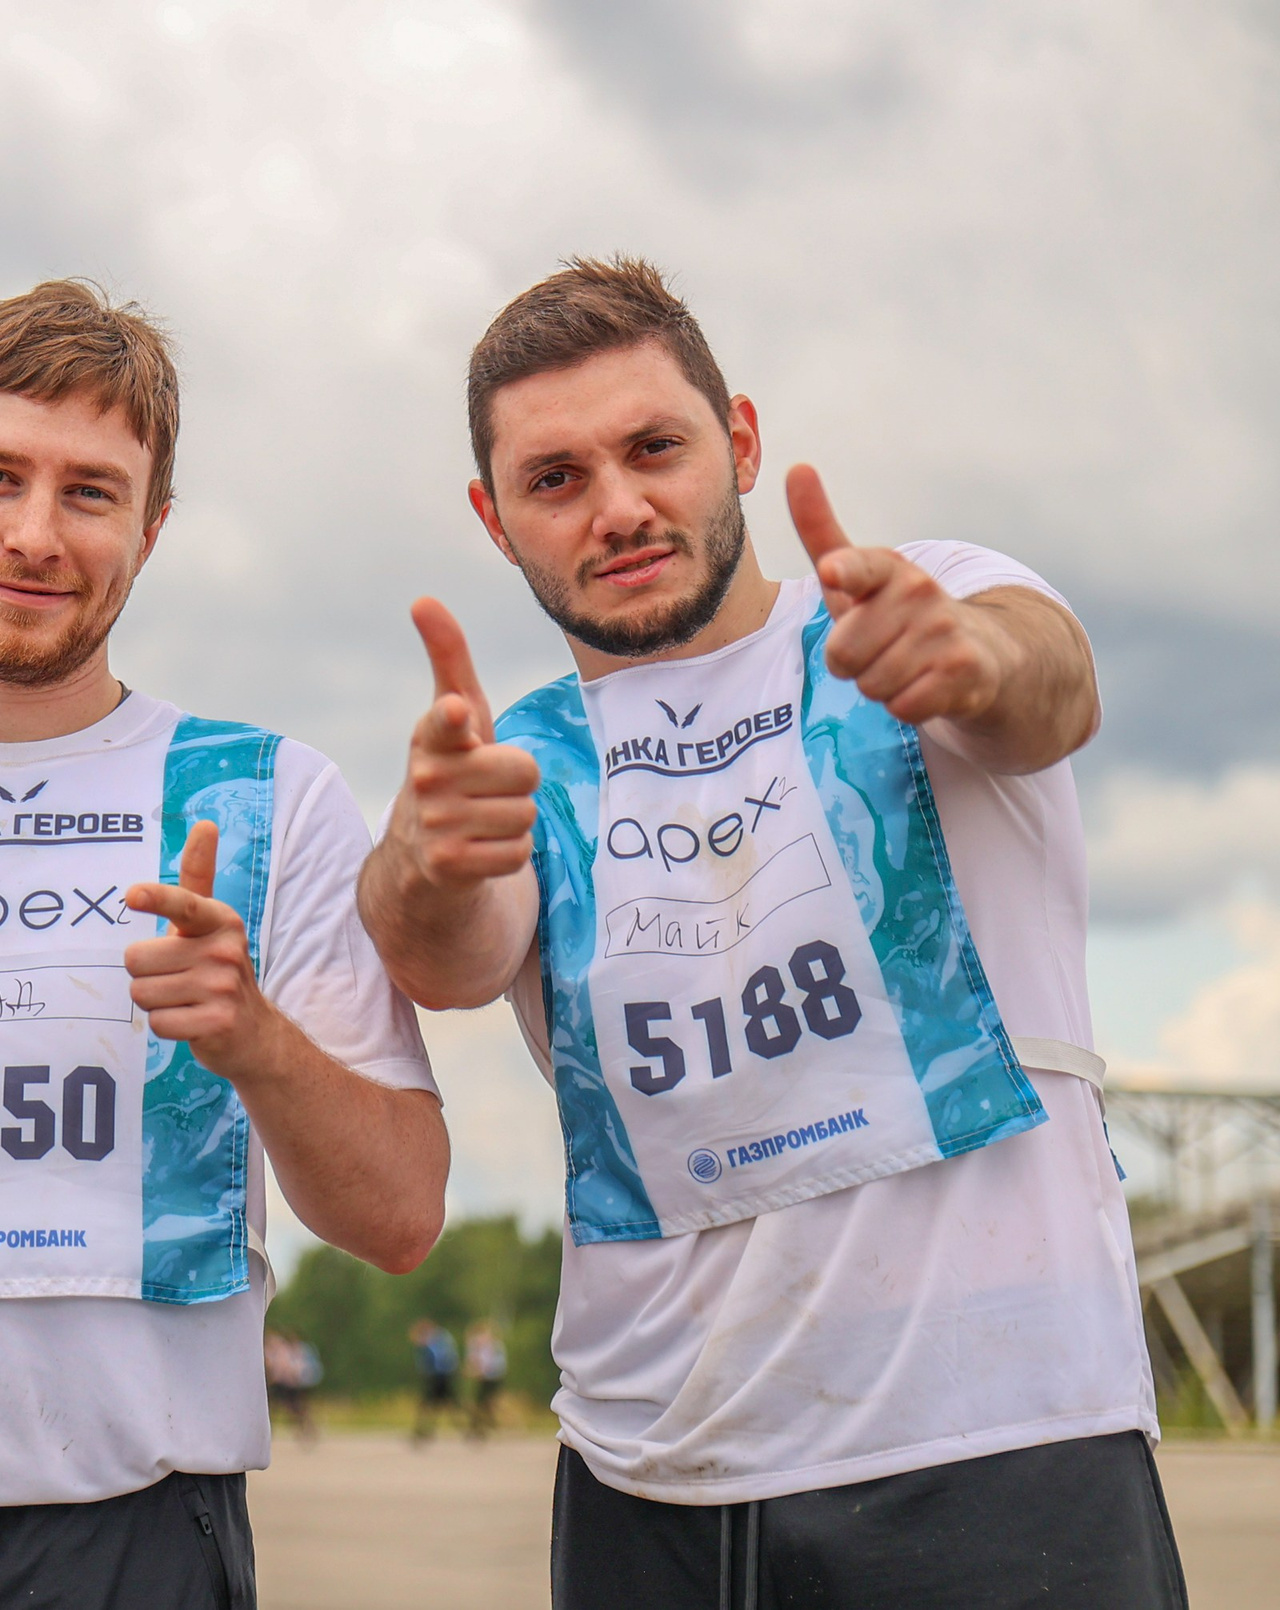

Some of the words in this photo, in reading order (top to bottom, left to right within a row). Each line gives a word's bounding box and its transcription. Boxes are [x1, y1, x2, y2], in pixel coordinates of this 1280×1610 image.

[606, 736, 670, 774] НКА
[677, 703, 793, 767] ГЕРОЕВ
[13, 813, 144, 836] ГЕРОЕВ
[607, 776, 781, 873] apex
[624, 940, 862, 1096] 5188
[727, 1109, 870, 1167] ГАЗПРОМБАНК
